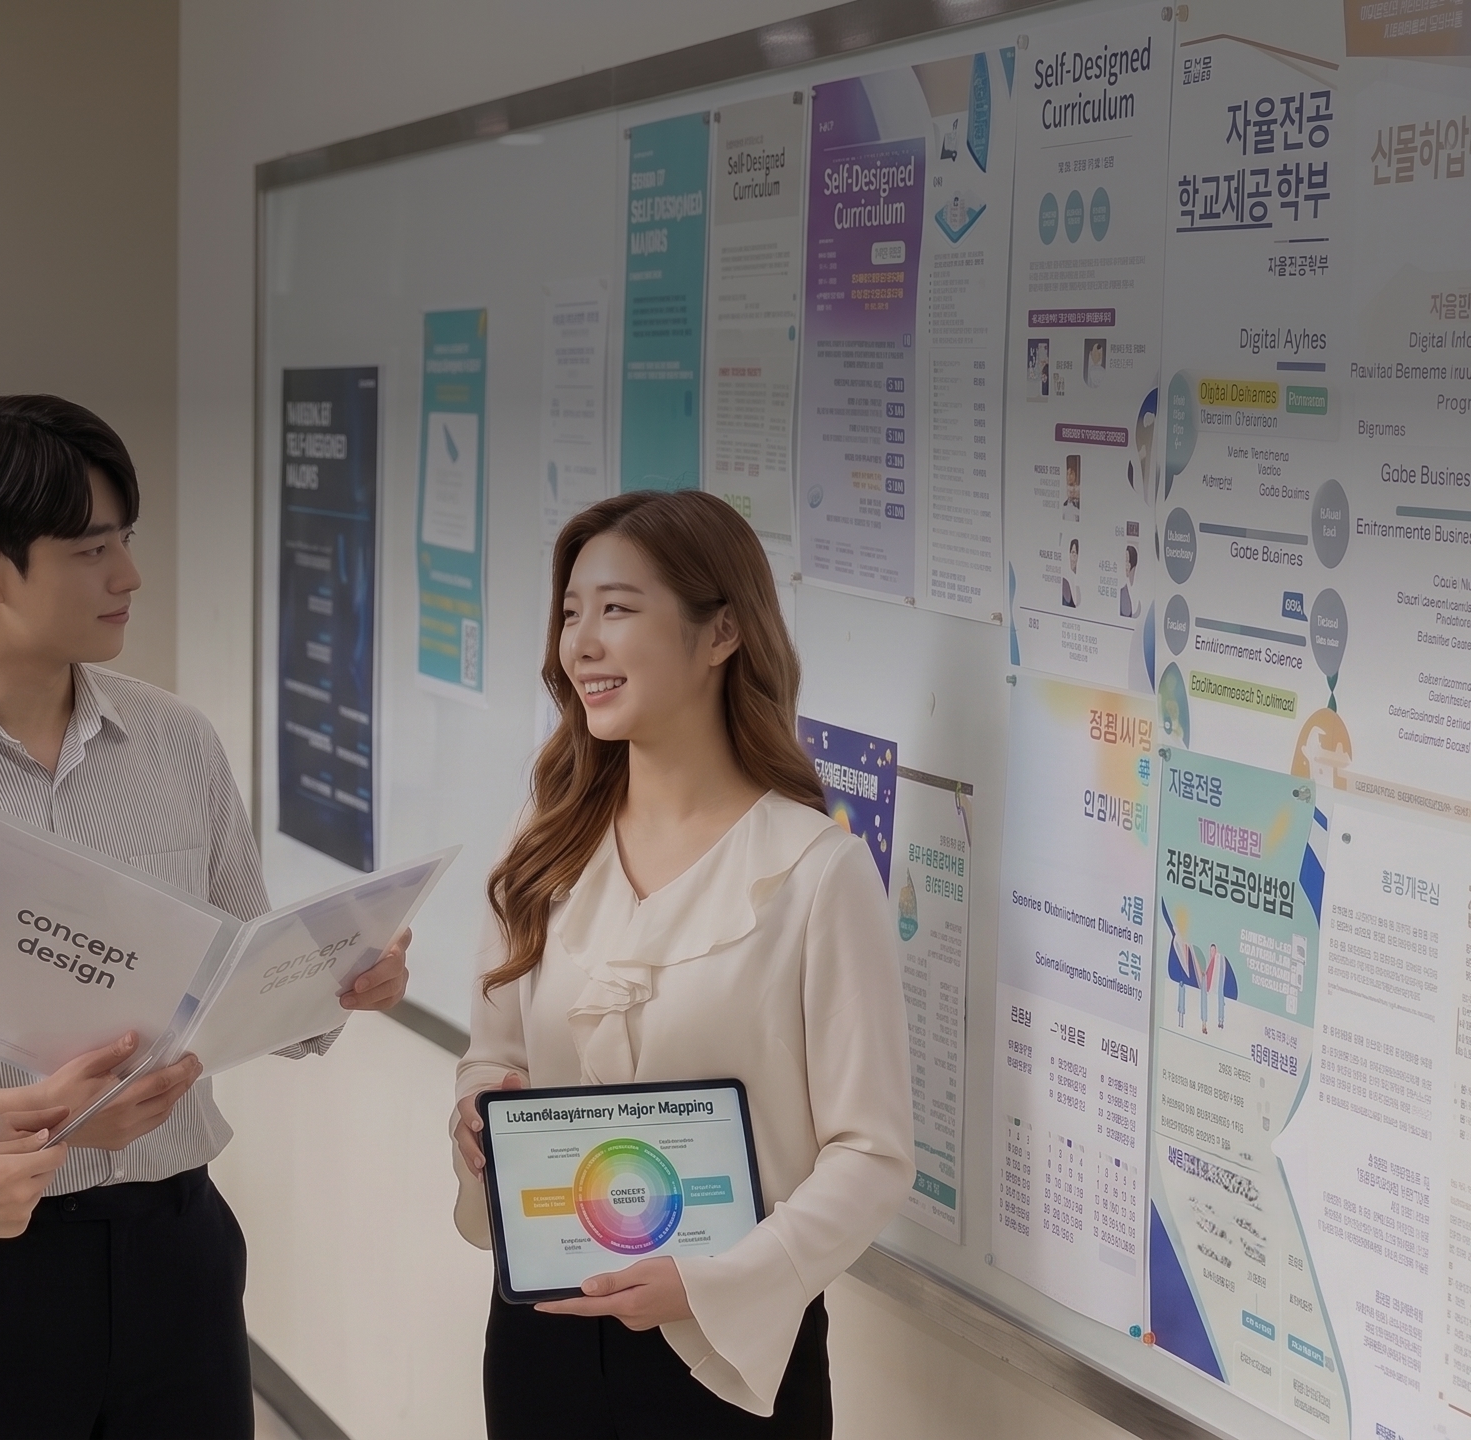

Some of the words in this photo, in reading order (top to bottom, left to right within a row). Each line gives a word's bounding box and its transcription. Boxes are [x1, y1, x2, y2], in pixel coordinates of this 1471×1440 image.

[1034, 36, 1152, 90] Self-Designed
[1042, 88, 1135, 130] Curriculum
[1225, 90, 1334, 156] 자율전공
[733, 175, 781, 201] Curriculum
[823, 156, 915, 197] Self-Designed
[834, 197, 906, 230] Curriculum
[1239, 327, 1281, 355] Digital
[1409, 331, 1448, 353] Digital
[1264, 647, 1303, 669] Science
[16, 907, 140, 972] concept
[262, 930, 362, 979] concept
[16, 935, 117, 991] design
[259, 956, 338, 995] design
[617, 1103, 656, 1120] Major
[657, 1099, 714, 1117] Mapping
